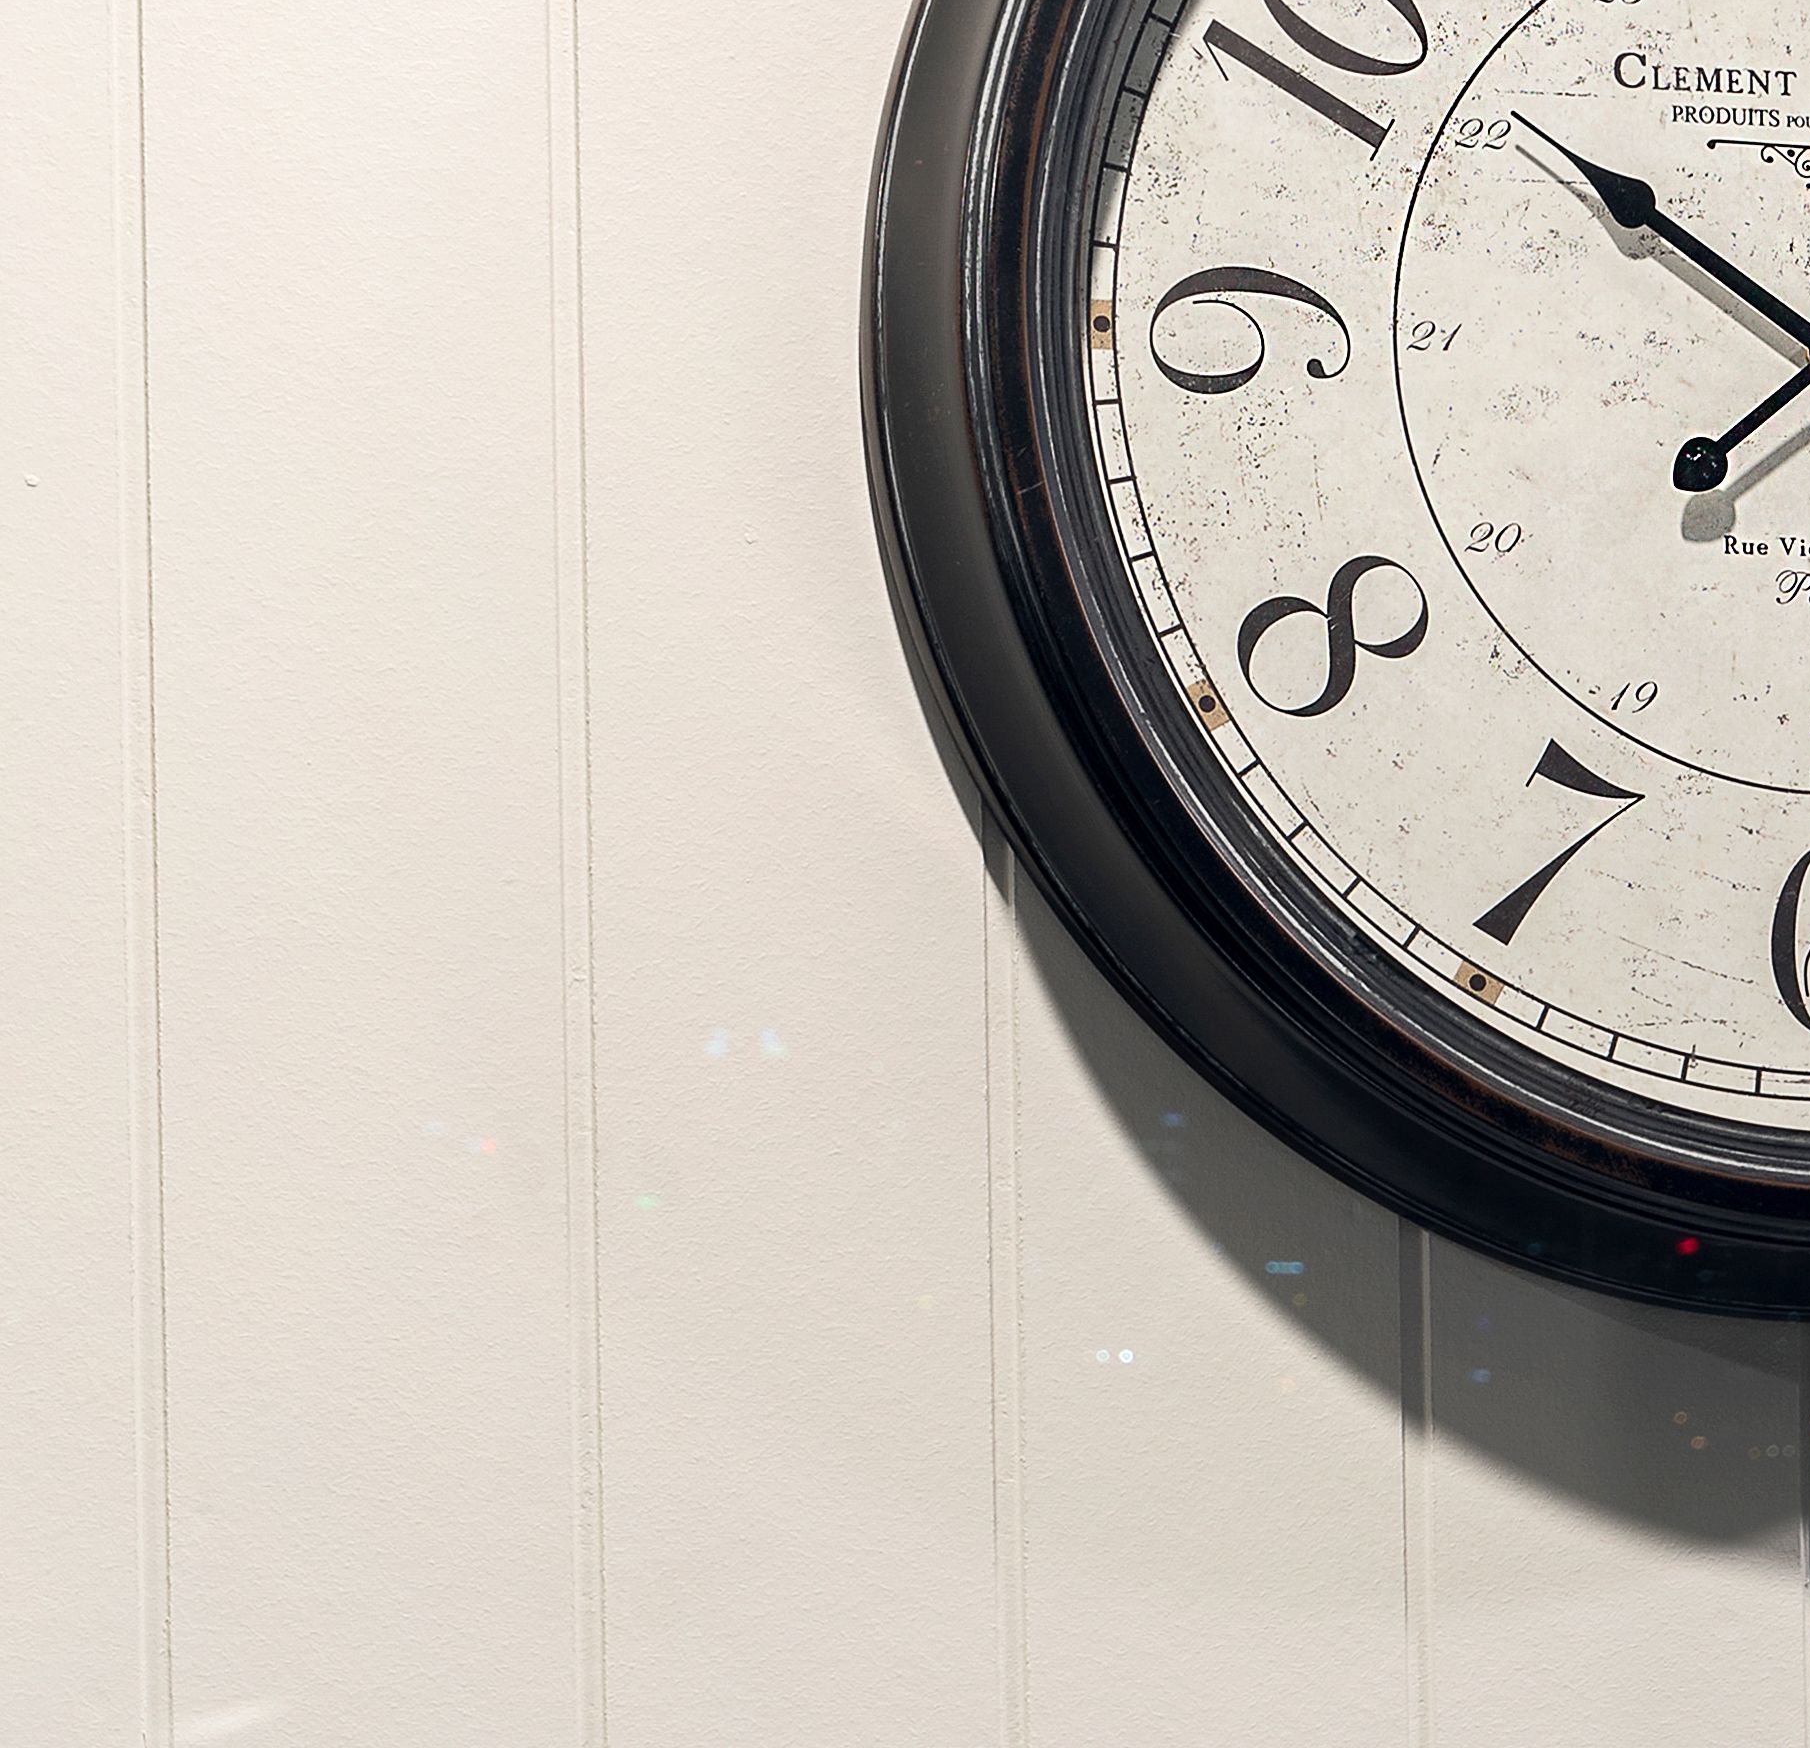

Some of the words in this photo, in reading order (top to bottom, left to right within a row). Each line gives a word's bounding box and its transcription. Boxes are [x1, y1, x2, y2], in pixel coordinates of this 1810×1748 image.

[1612, 53, 1798, 98] CLEMENT
[1455, 118, 1511, 150] 22
[1672, 108, 1780, 129] PRODUITS
[1148, 265, 1352, 397] 9
[1409, 322, 1458, 353] 21
[1465, 522, 1521, 554] 20
[1723, 536, 1770, 557] Rue
[1235, 554, 1430, 718] 8
[1609, 682, 1658, 714] 19
[1472, 738, 1645, 945] 7
